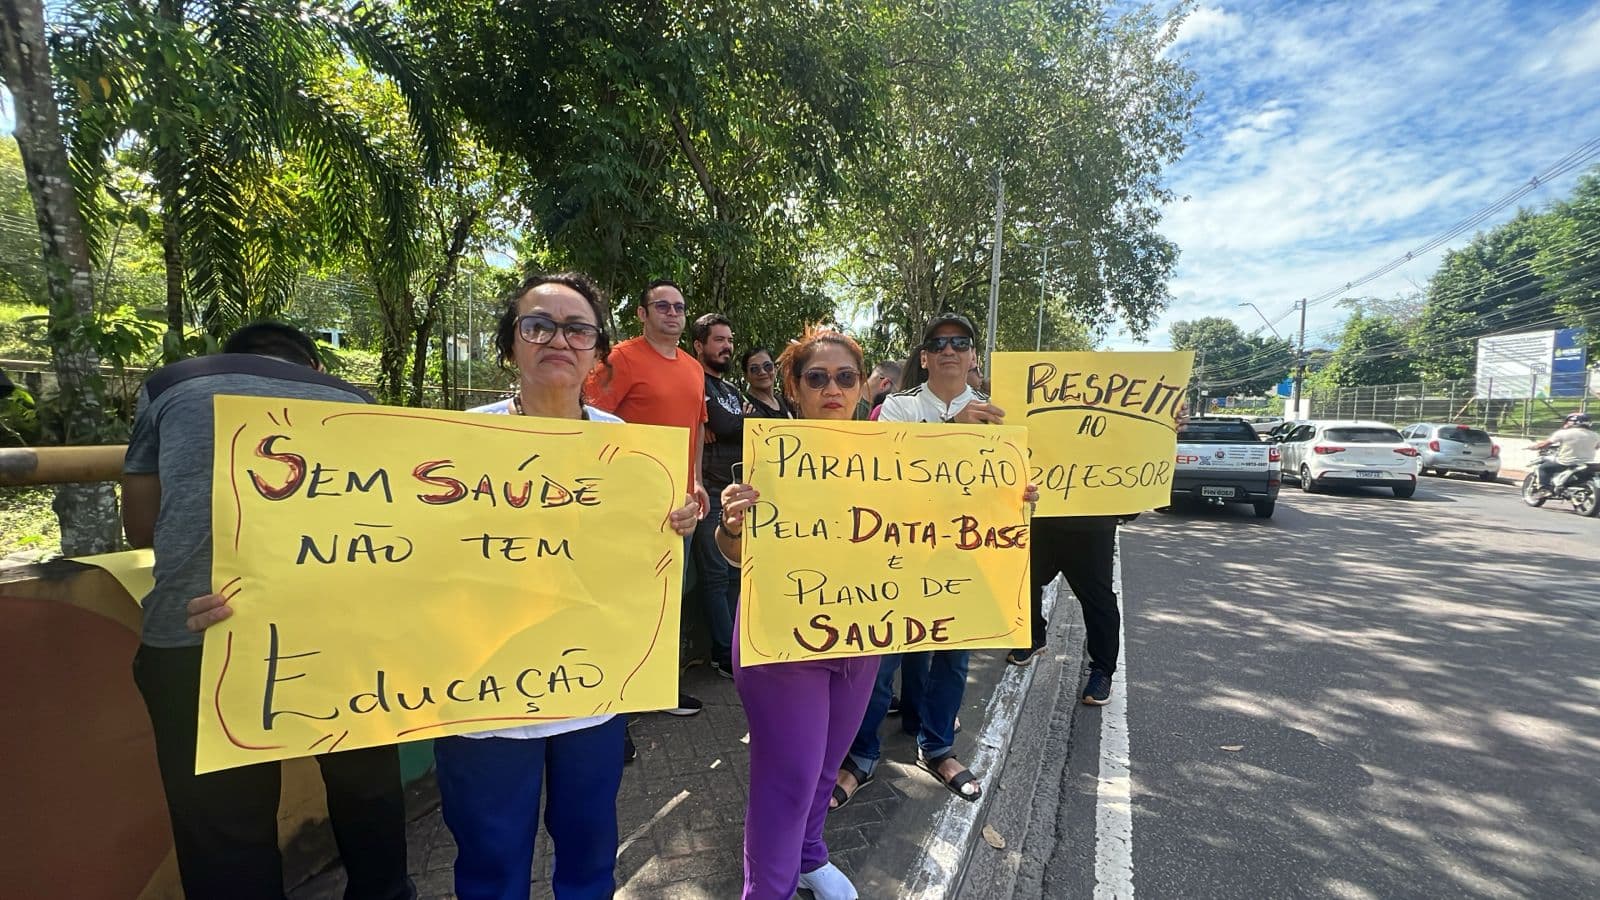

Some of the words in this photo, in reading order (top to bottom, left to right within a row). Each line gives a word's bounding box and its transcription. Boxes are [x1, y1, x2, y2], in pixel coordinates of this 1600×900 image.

[1076, 415, 1107, 437] AO
[247, 434, 393, 502] SEM
[412, 454, 604, 509] SAÚDE
[295, 522, 413, 565] NÃO
[460, 536, 574, 562] TEM
[848, 507, 1030, 551] DATA-BASE
[888, 555, 904, 570] E
[784, 569, 899, 605] PLANO
[920, 577, 972, 598] DE
[793, 609, 956, 653] SAÚDE
